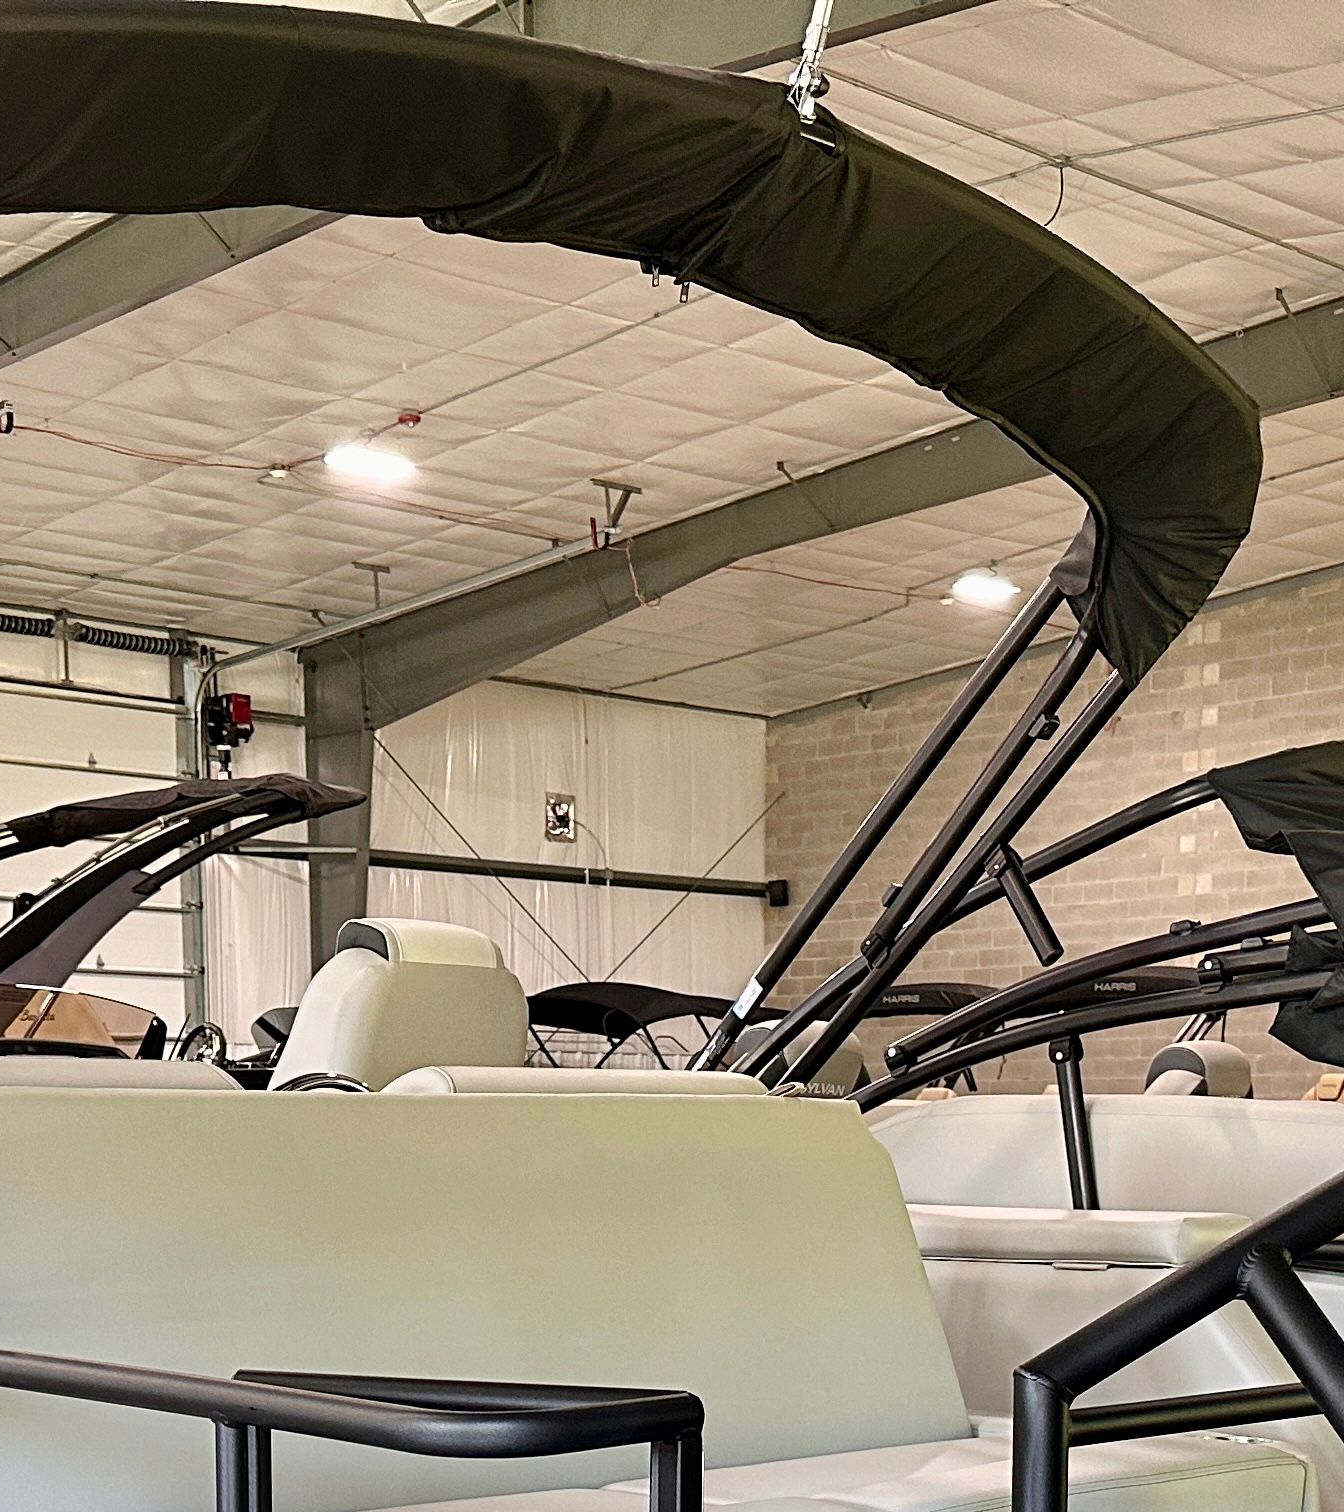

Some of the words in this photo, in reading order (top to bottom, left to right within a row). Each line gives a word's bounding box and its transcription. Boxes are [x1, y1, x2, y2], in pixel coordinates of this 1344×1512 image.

[1093, 981, 1137, 991] HARRIS
[882, 994, 920, 1003] HARRIS
[804, 1082, 845, 1096] YLVAN
